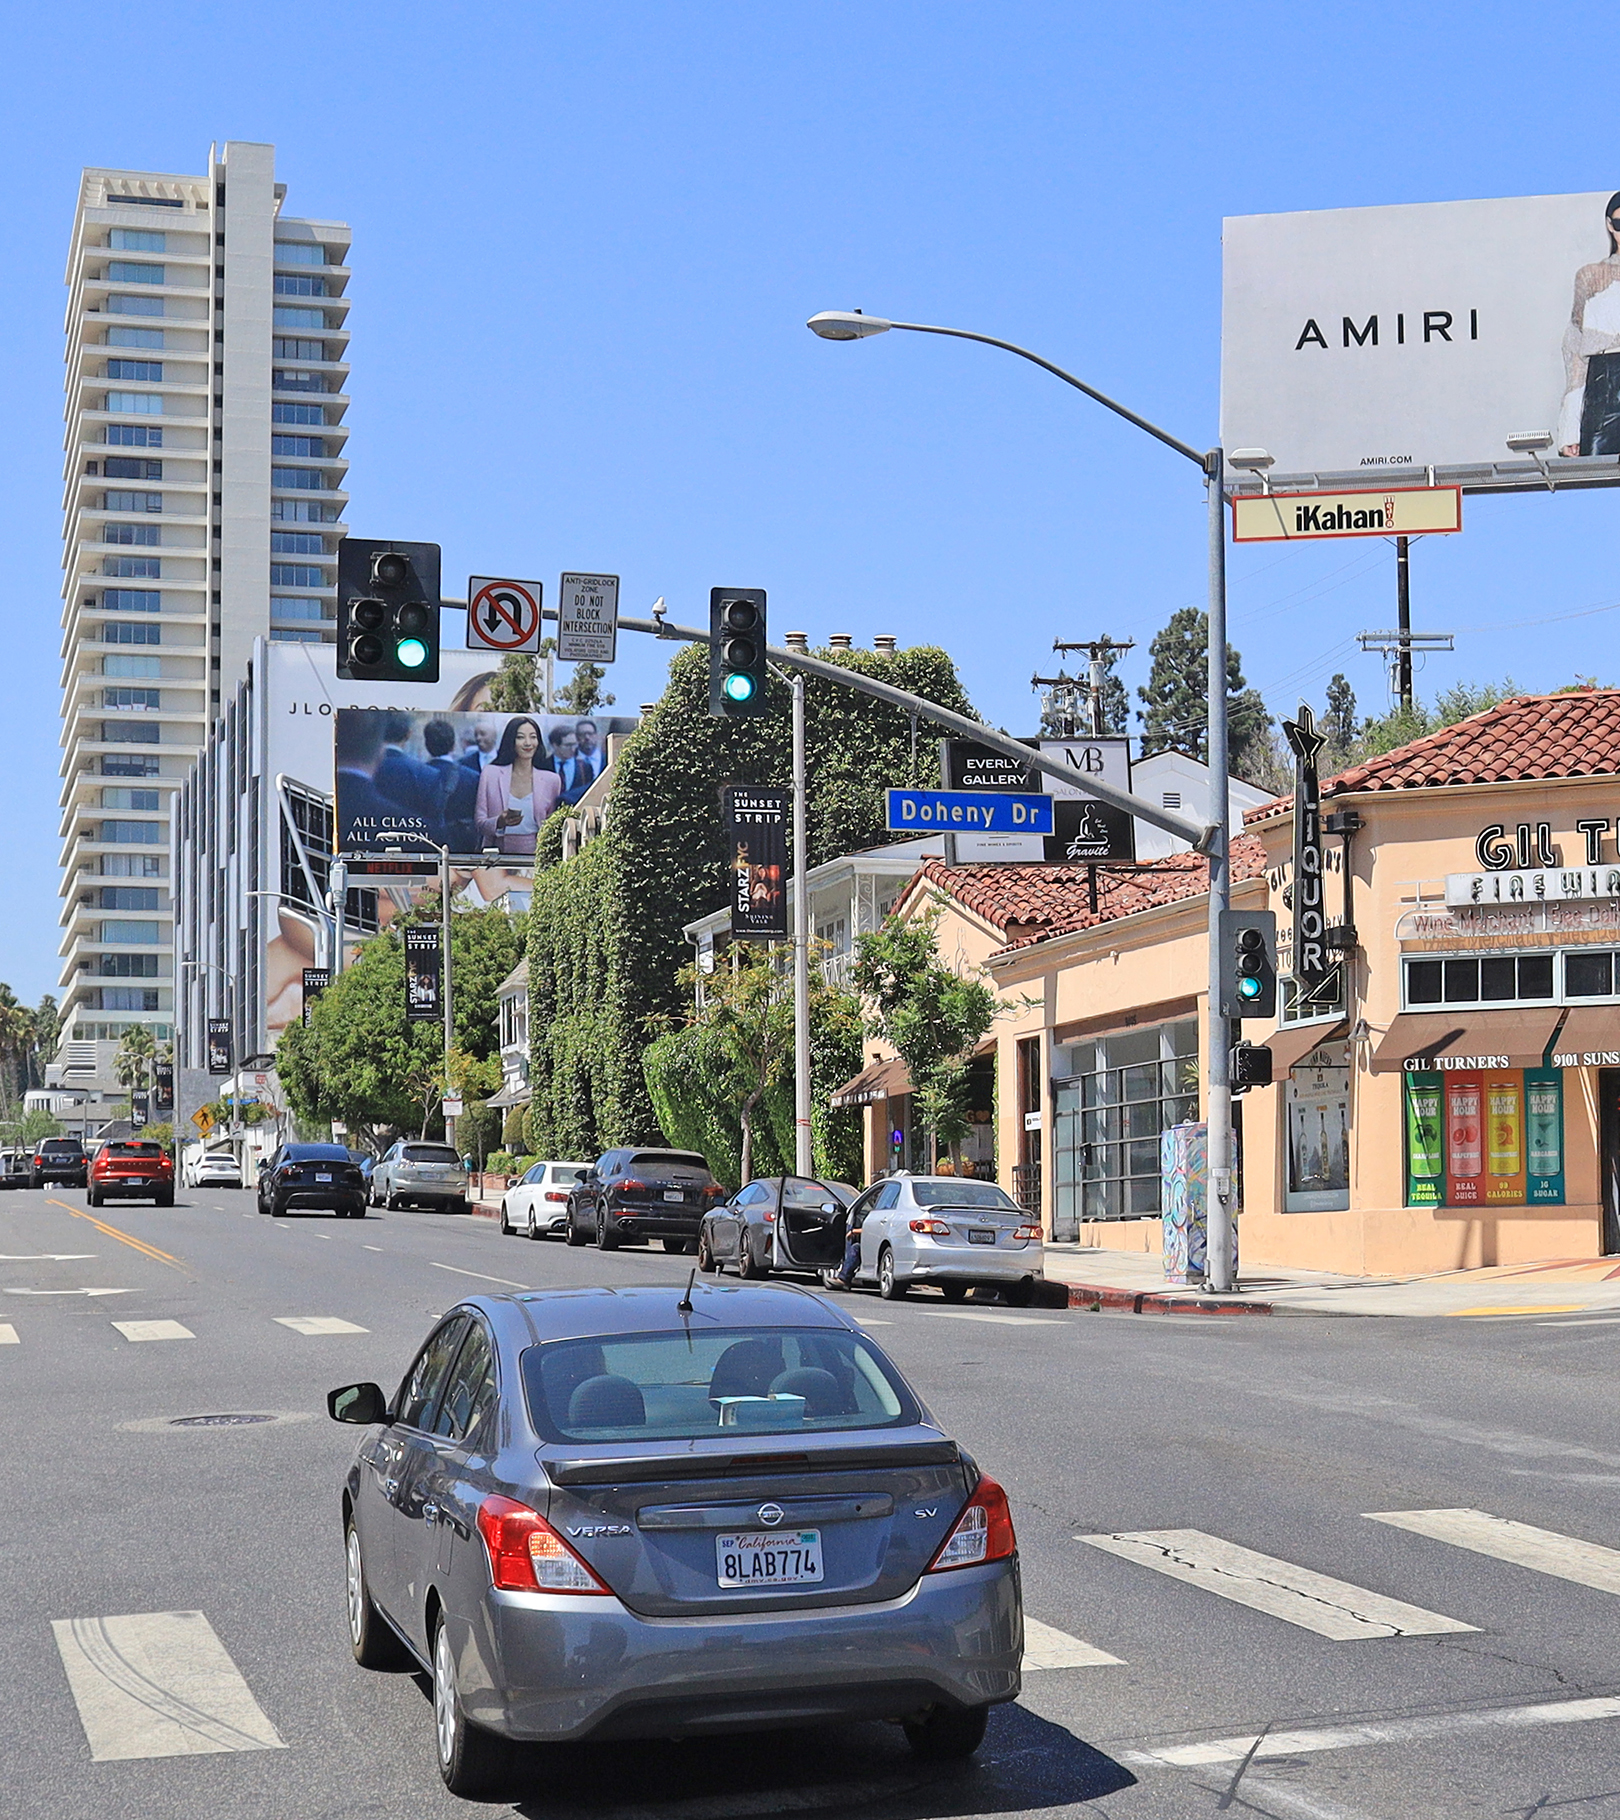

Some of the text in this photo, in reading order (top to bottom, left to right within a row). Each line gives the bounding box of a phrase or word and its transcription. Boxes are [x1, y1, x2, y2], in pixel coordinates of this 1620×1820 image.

[1295, 308, 1478, 350] AMIRI
[1360, 455, 1413, 466] AMIRI.COM
[1295, 503, 1384, 531] iKahan
[565, 577, 615, 587] ANTI-GRIDLOCK
[581, 586, 599, 594] ZONE
[574, 595, 604, 607] DO NOT
[576, 608, 601, 620] BLOCK
[563, 621, 612, 634] INTERSECTION
[289, 702, 332, 715] JLO
[966, 759, 1021, 769] EVERLY
[962, 774, 1027, 785] GALLERY
[734, 800, 782, 808] SUNSET
[734, 814, 782, 823] STRIP
[901, 799, 1039, 828] Doheny Dr
[353, 817, 427, 828] ALL CLASS.
[347, 832, 370, 842] ALL
[1475, 821, 1556, 872] GIL
[366, 862, 413, 874] NETFLIX
[736, 841, 750, 912] STARZ FYC
[1301, 780, 1323, 972] LIQUOR
[1471, 874, 1546, 904] FINE
[1414, 914, 1453, 932] Wine
[1458, 908, 1535, 932] Merchant
[1551, 905, 1582, 926] Free
[410, 976, 418, 1004] STARZ
[1403, 1055, 1510, 1071] GIL TURNER'S
[1553, 1053, 1579, 1068] 9101
[1451, 1096, 1478, 1106] HAPPY
[1490, 1096, 1516, 1106] HAPPY
[1530, 1094, 1556, 1104] HAPPY
[1453, 1106, 1476, 1116] HOUR
[1492, 1105, 1515, 1114] HOUR
[1532, 1104, 1555, 1113] HOUR
[1456, 1182, 1476, 1190] REAL
[1411, 1192, 1442, 1201] TEQUILA
[1455, 1191, 1477, 1200] JUICE
[1486, 1190, 1523, 1198] CALORIES
[1534, 1189, 1558, 1197] SUGAR
[914, 1508, 938, 1518] SV
[566, 1525, 631, 1537] VERSA
[722, 1540, 734, 1548] SEP
[738, 1536, 802, 1551] California
[724, 1550, 816, 1578] 8LAB774
